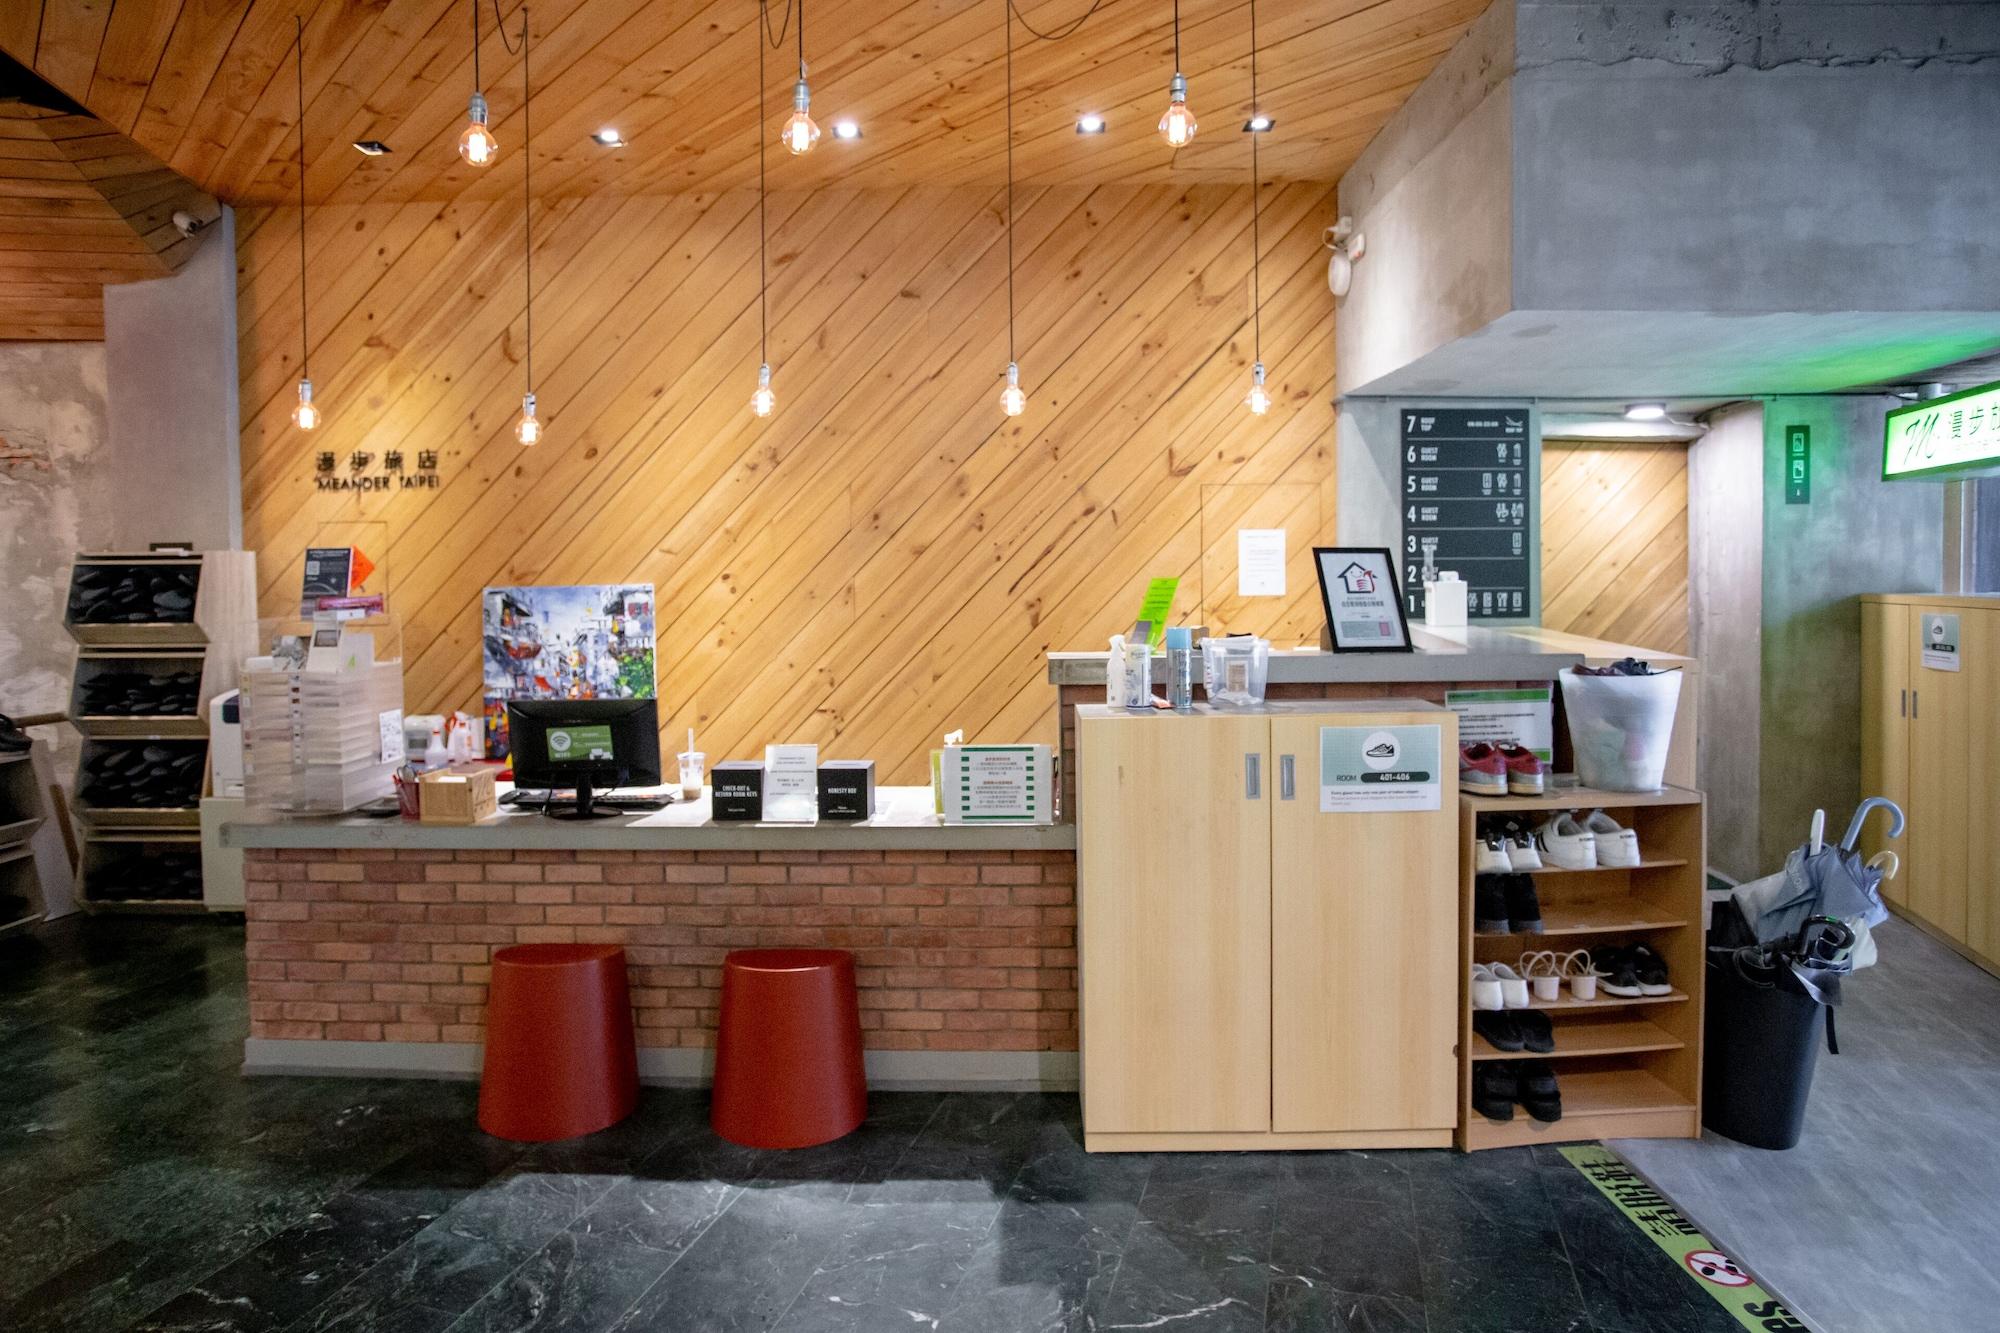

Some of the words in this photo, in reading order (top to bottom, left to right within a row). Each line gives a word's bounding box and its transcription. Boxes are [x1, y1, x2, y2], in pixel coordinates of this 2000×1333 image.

[1406, 415, 1416, 433] 7
[1407, 445, 1416, 463] 6
[317, 476, 390, 491] MEANDER
[400, 475, 440, 489] TAIPEI
[1407, 475, 1416, 492] 5
[1407, 505, 1416, 522] 4
[1407, 535, 1416, 553] 3
[1408, 565, 1416, 582] 2
[1408, 595, 1415, 612] 1
[1580, 1158, 1702, 1239] 請脫鞋
